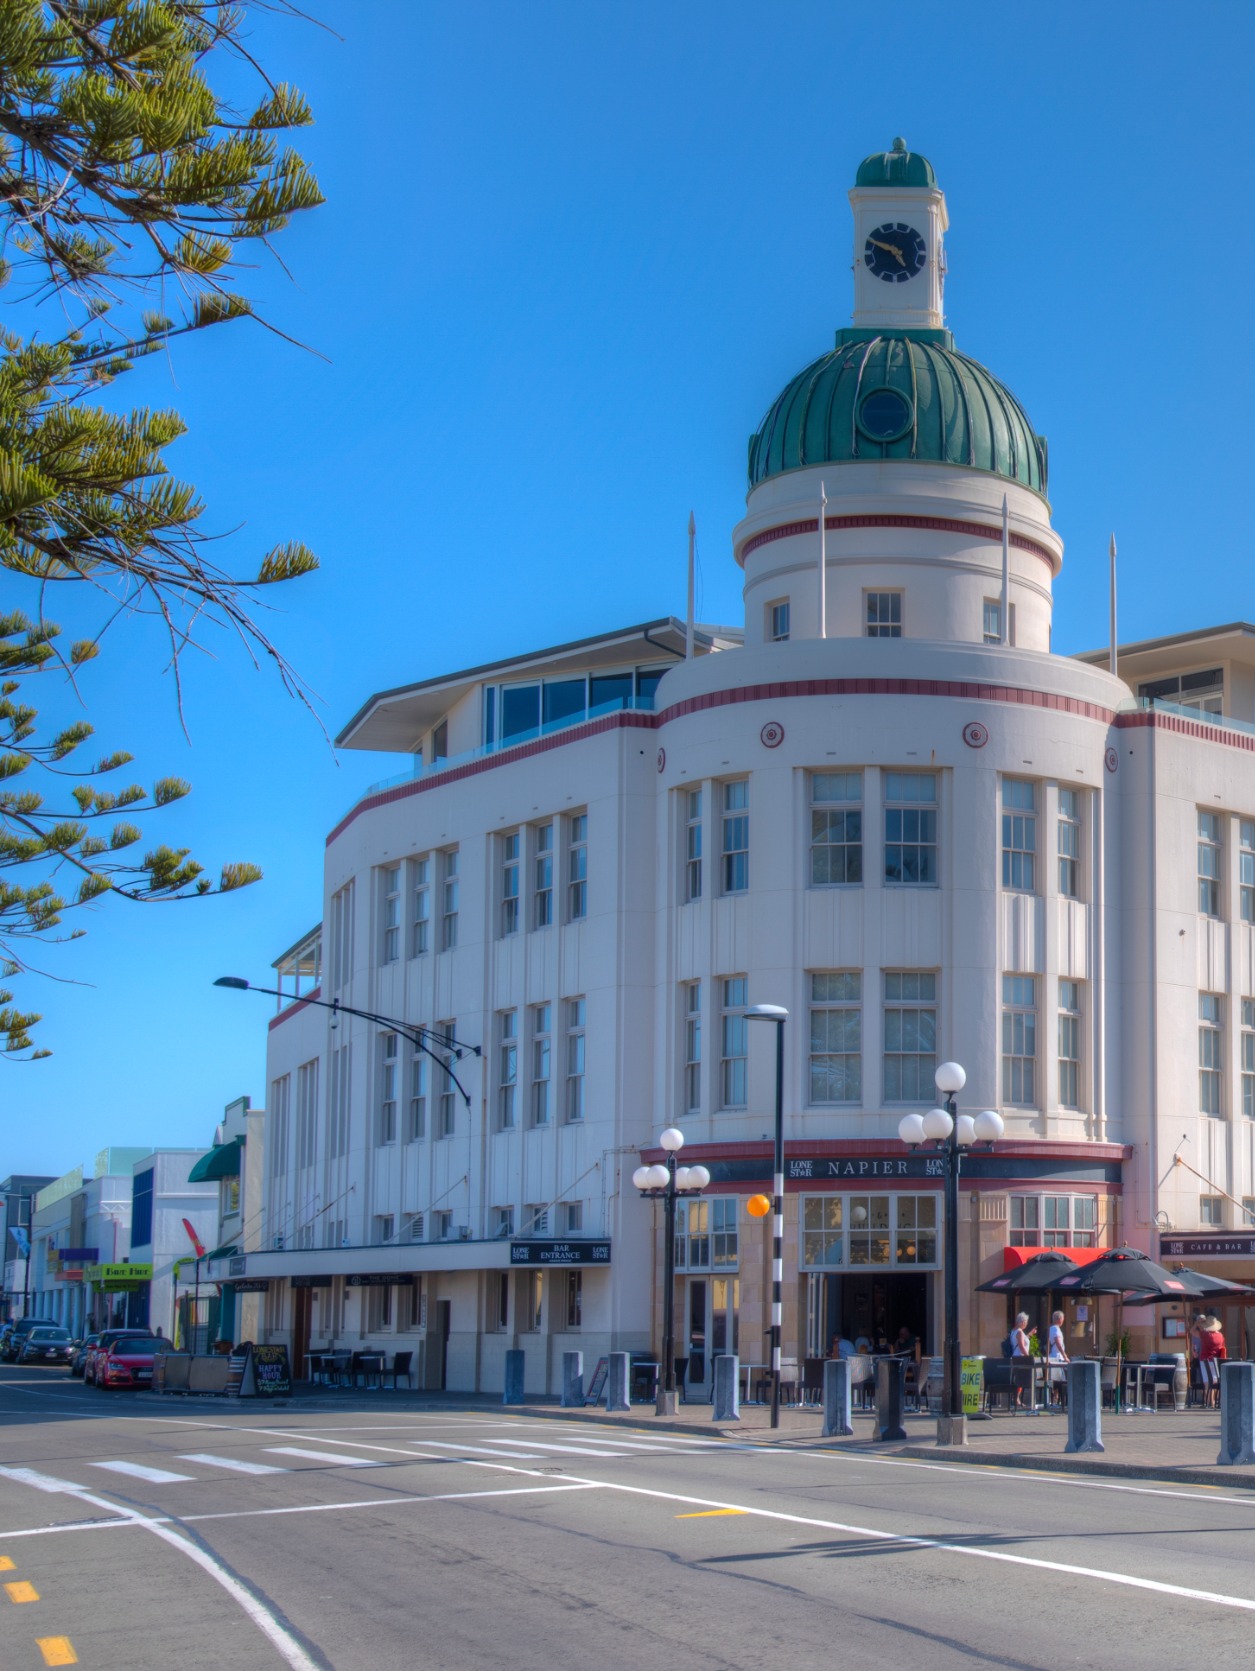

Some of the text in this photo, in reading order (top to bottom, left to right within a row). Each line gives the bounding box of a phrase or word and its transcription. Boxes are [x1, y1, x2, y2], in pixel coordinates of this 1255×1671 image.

[790, 1160, 813, 1169] LONE
[926, 1159, 944, 1167] LON
[828, 1161, 908, 1175] NAPIER
[925, 1167, 945, 1176] STA
[553, 1244, 570, 1252] BAR
[540, 1251, 581, 1259] ENTRANCE
[258, 1364, 283, 1372] HAPPY
[262, 1371, 282, 1380] HOUR
[961, 1373, 980, 1386] BIKE
